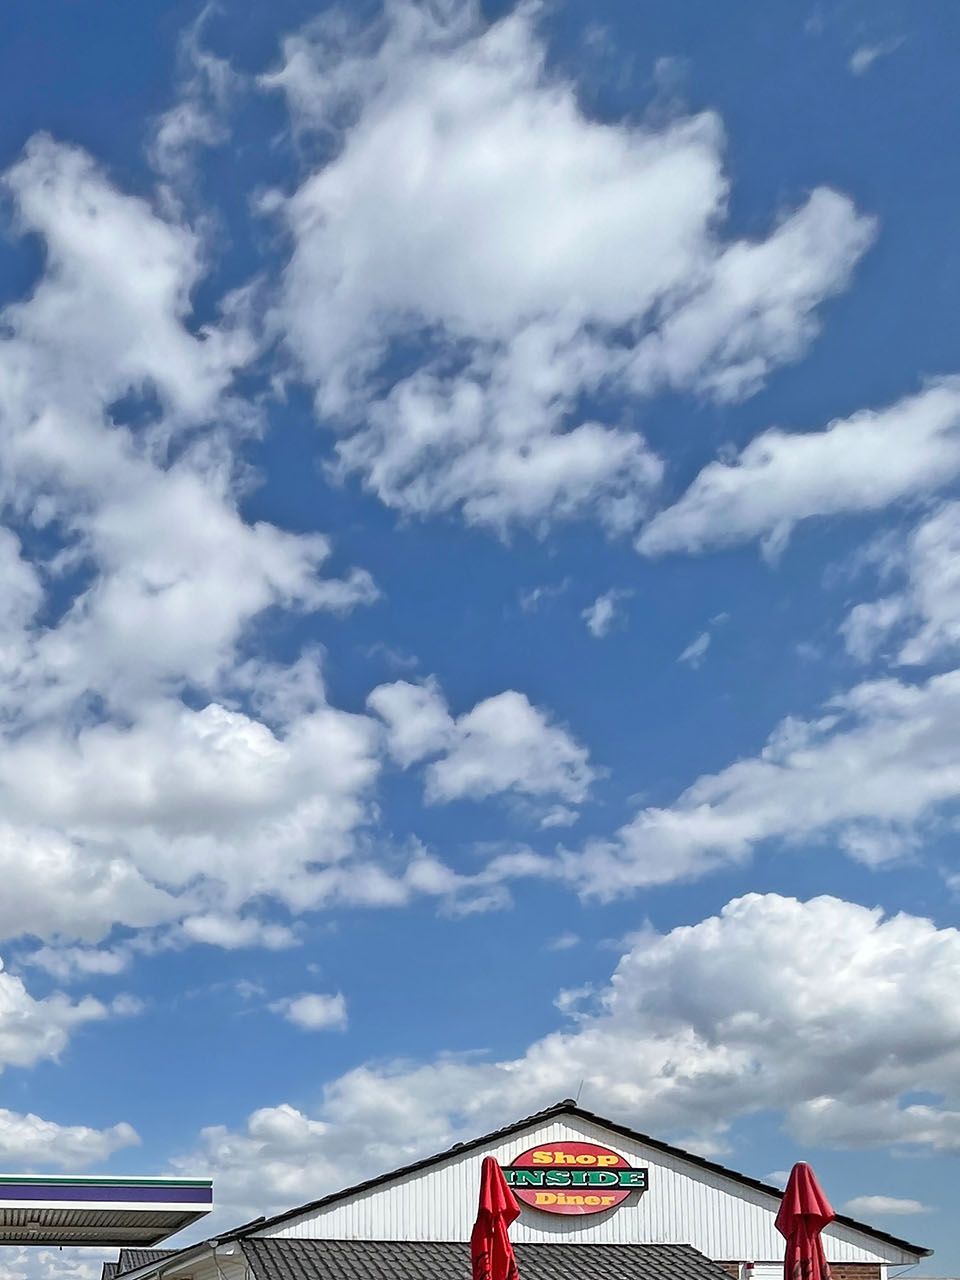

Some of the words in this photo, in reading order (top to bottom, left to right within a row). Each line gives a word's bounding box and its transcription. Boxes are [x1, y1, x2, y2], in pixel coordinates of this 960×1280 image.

[532, 1151, 620, 1167] Shop
[503, 1170, 645, 1187] INSIDE
[535, 1192, 616, 1206] Diner
